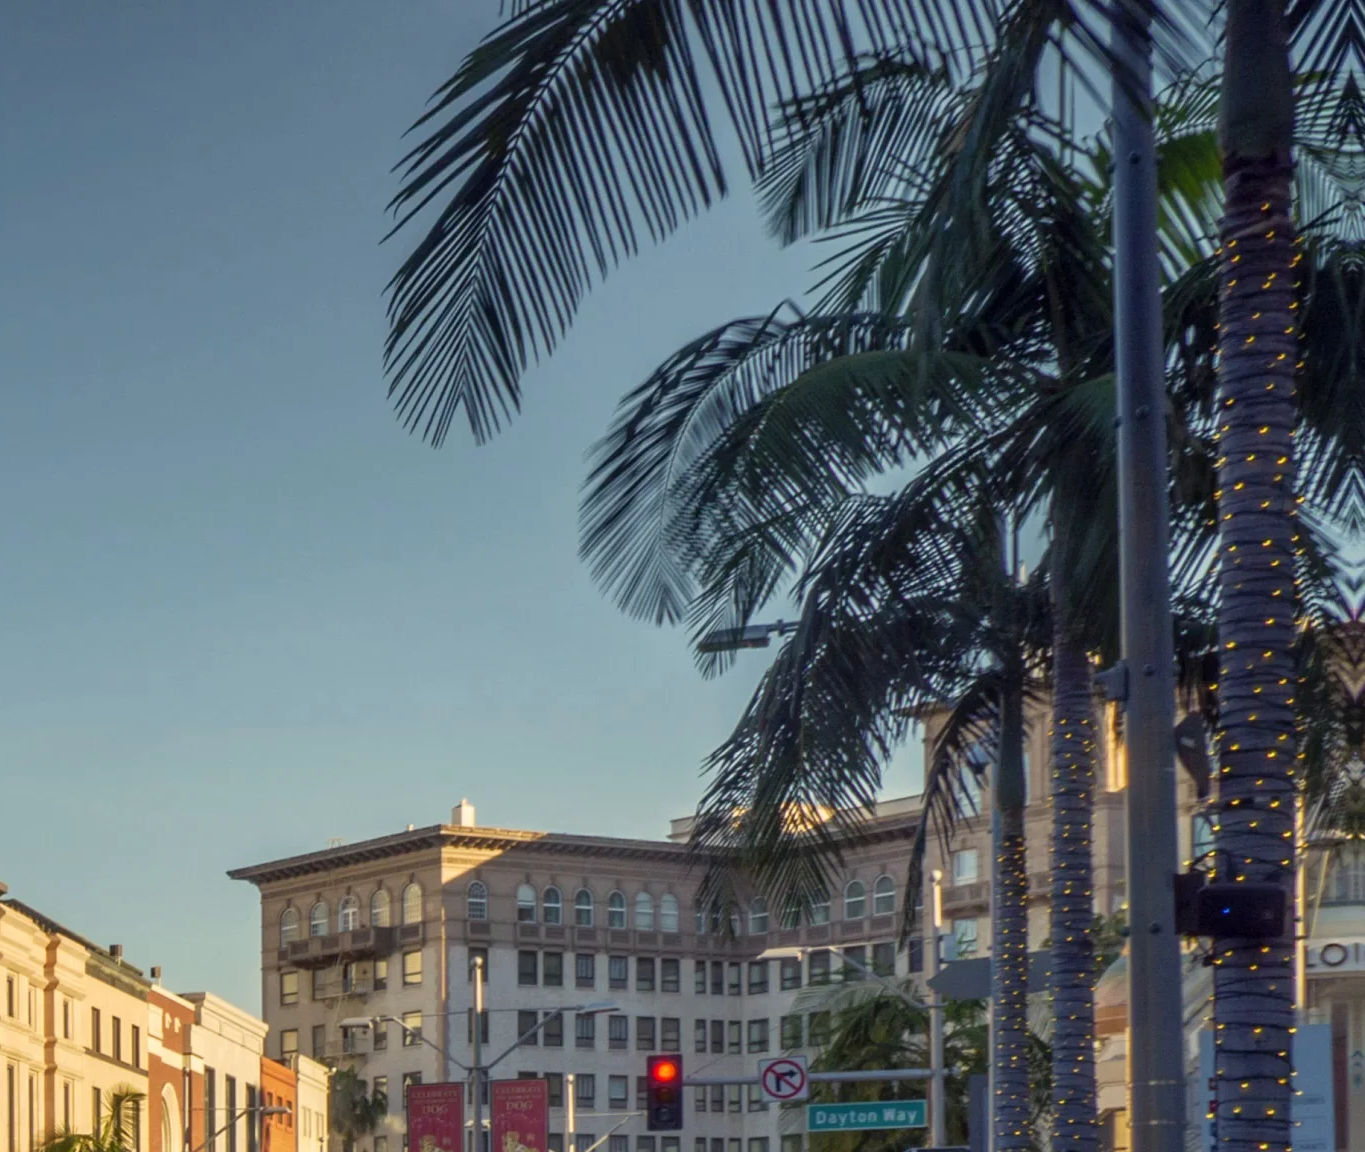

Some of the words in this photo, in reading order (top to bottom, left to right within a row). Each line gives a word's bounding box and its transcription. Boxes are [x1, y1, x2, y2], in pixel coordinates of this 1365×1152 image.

[506, 1100, 533, 1110] DOG
[815, 1109, 878, 1126] Dayton
[882, 1108, 917, 1124] Way
